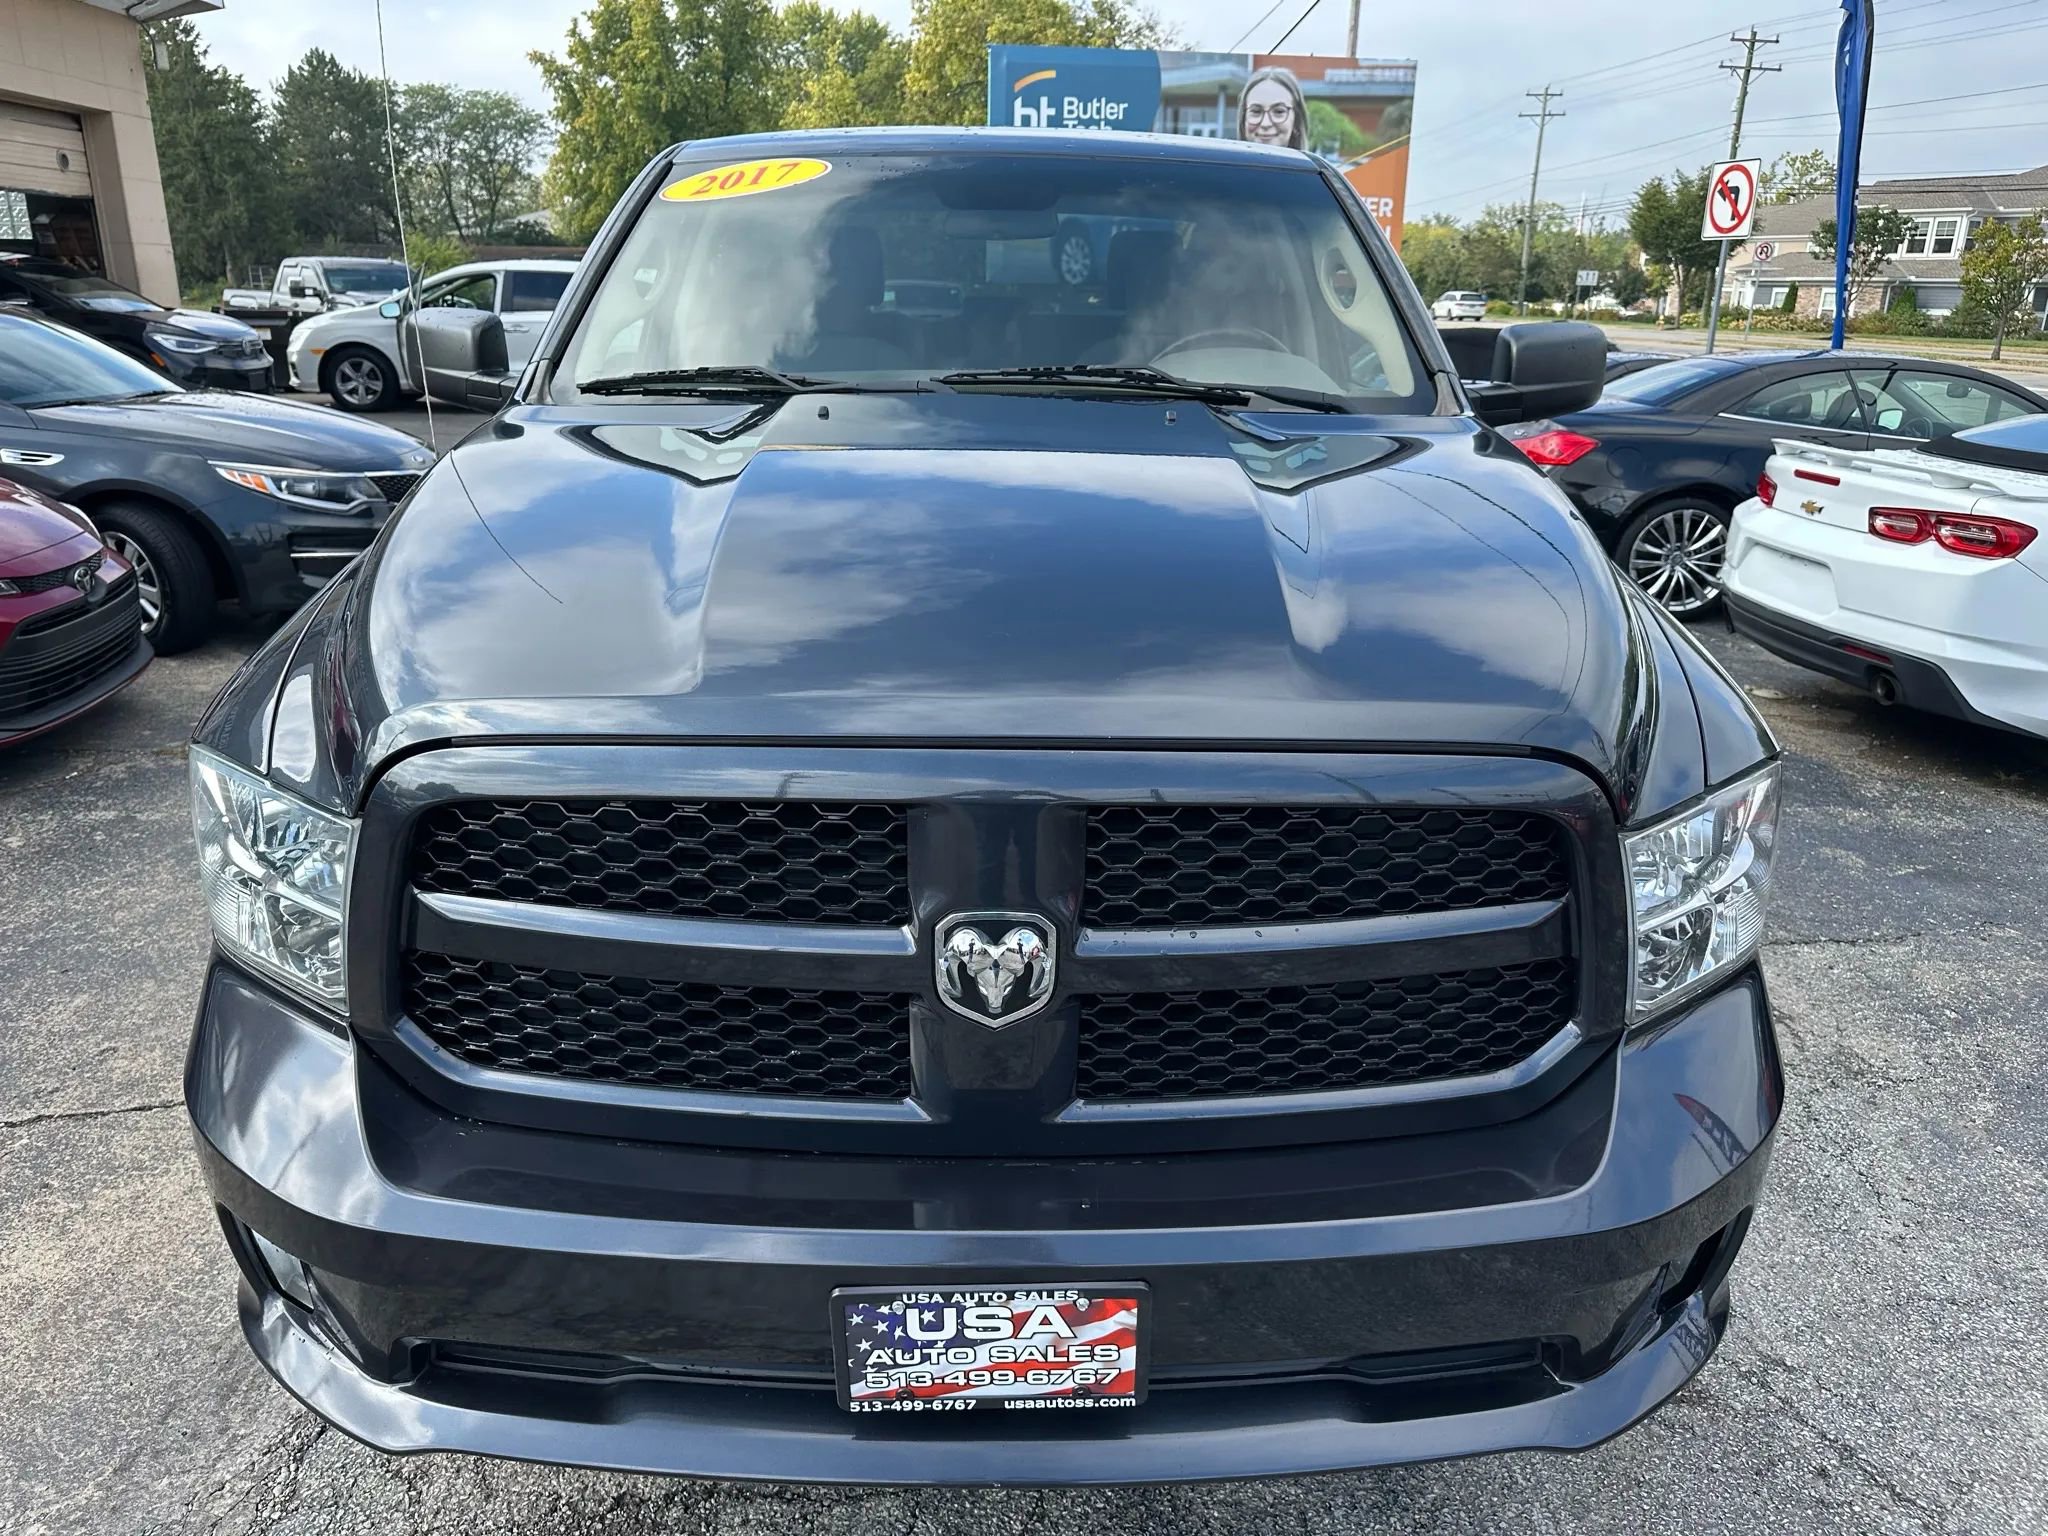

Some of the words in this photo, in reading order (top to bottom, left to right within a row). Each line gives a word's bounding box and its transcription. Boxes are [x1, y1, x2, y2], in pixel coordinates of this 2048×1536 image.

[1063, 96, 1128, 120] Butler
[690, 162, 801, 196] 2017
[1361, 197, 1393, 217] ER
[902, 1293, 945, 1304] USA
[951, 1292, 1007, 1303] AUTO
[1014, 1290, 1079, 1301] SALES
[905, 1305, 1077, 1341] USA
[865, 1347, 976, 1366] AUTO
[988, 1344, 1121, 1364] SALES
[865, 1367, 1121, 1389] 513-499-6767
[850, 1399, 977, 1412] 513-499-6767
[1004, 1396, 1136, 1409] usaautoss.com
